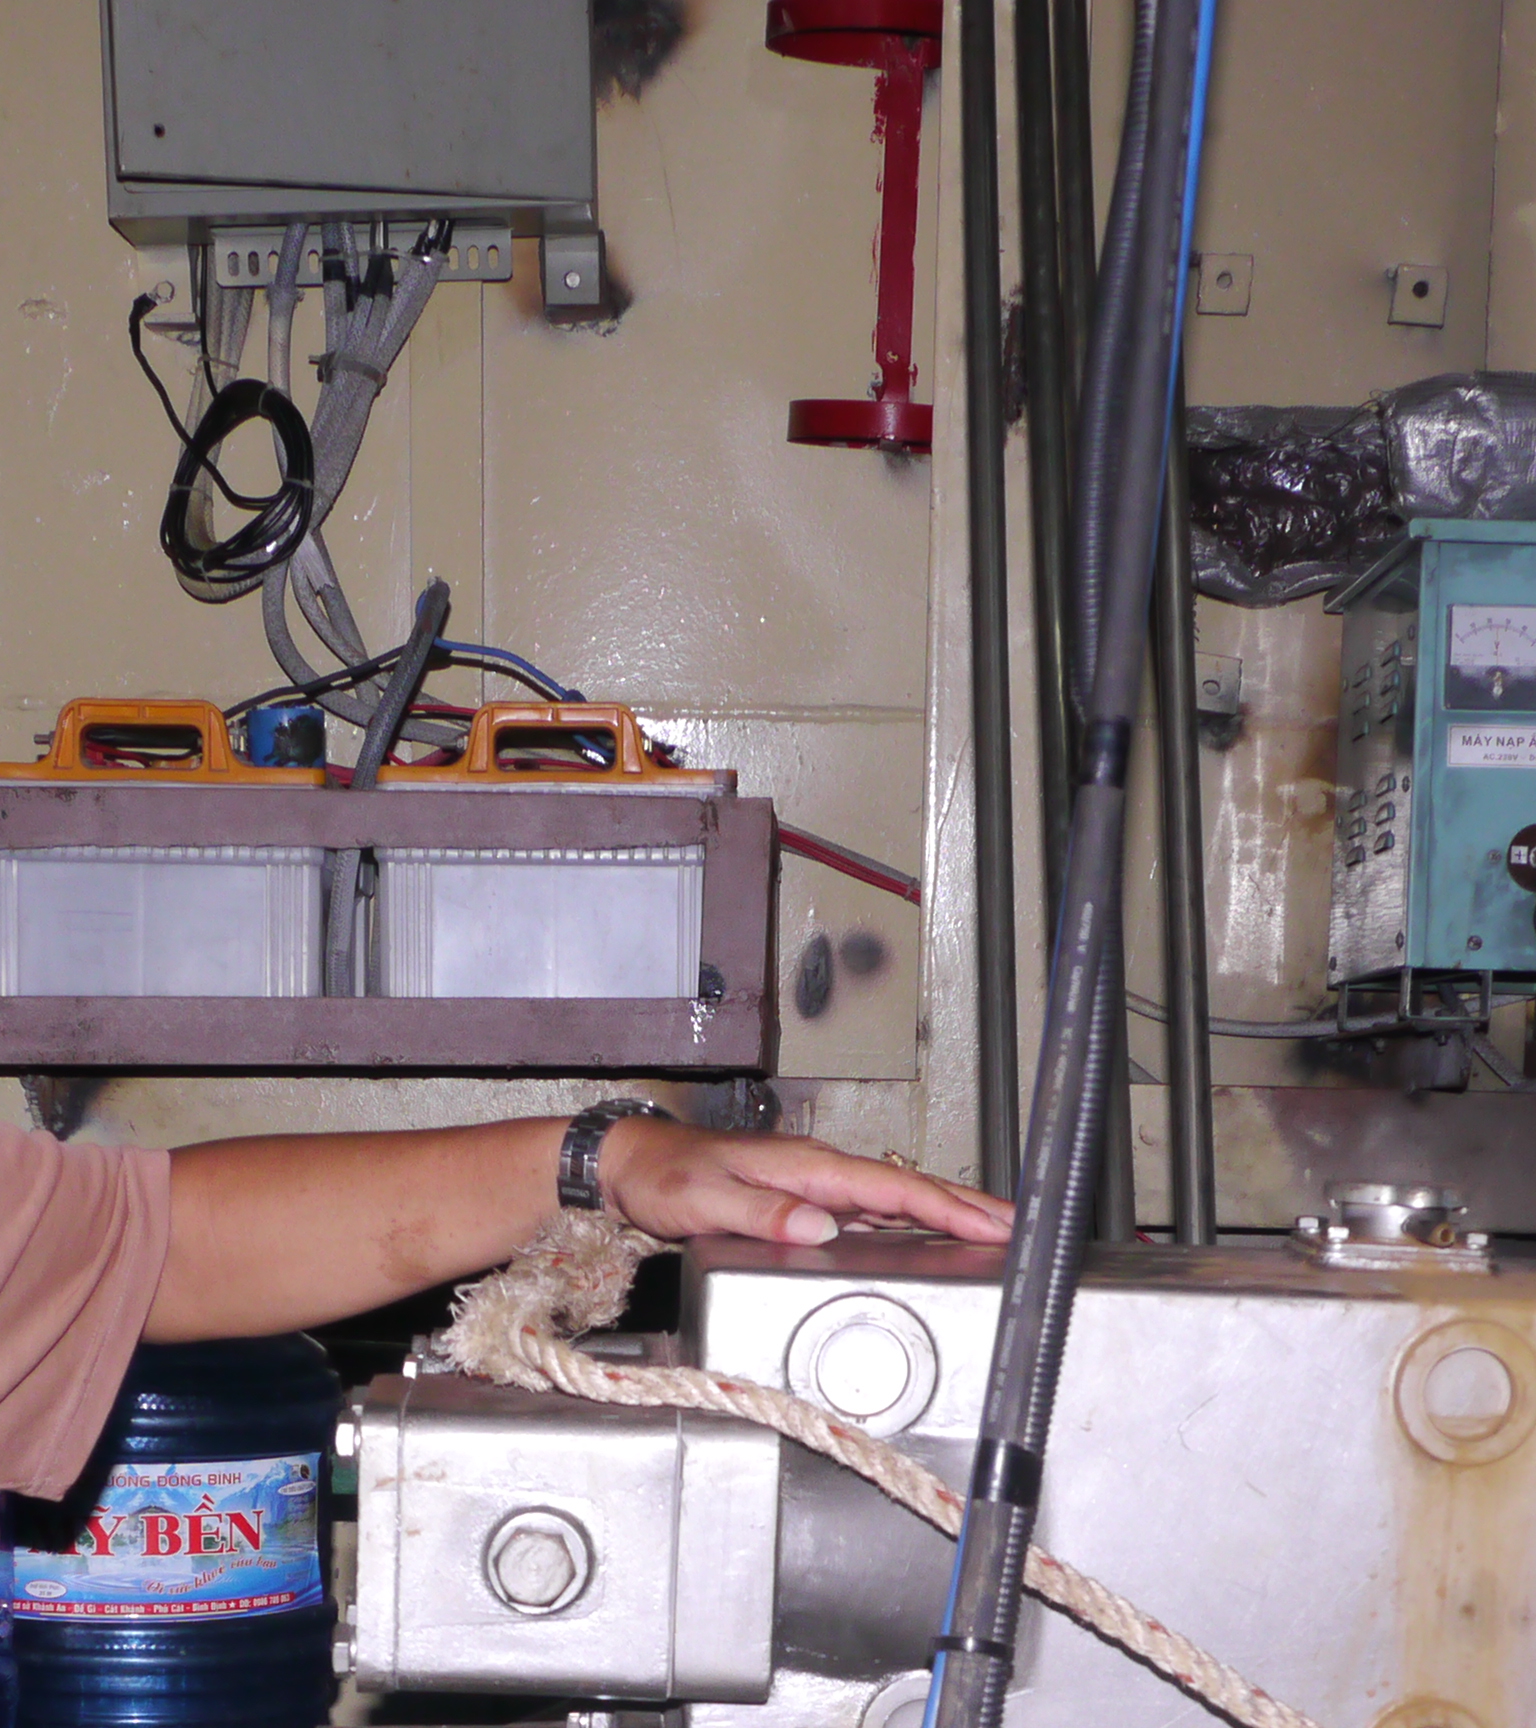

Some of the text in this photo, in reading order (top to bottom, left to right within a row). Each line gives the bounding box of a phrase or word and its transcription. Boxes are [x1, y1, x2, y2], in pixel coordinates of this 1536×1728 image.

[1461, 732, 1492, 746] MÁY
[1496, 735, 1525, 750] NẠP
[141, 1493, 264, 1556] BỀN
